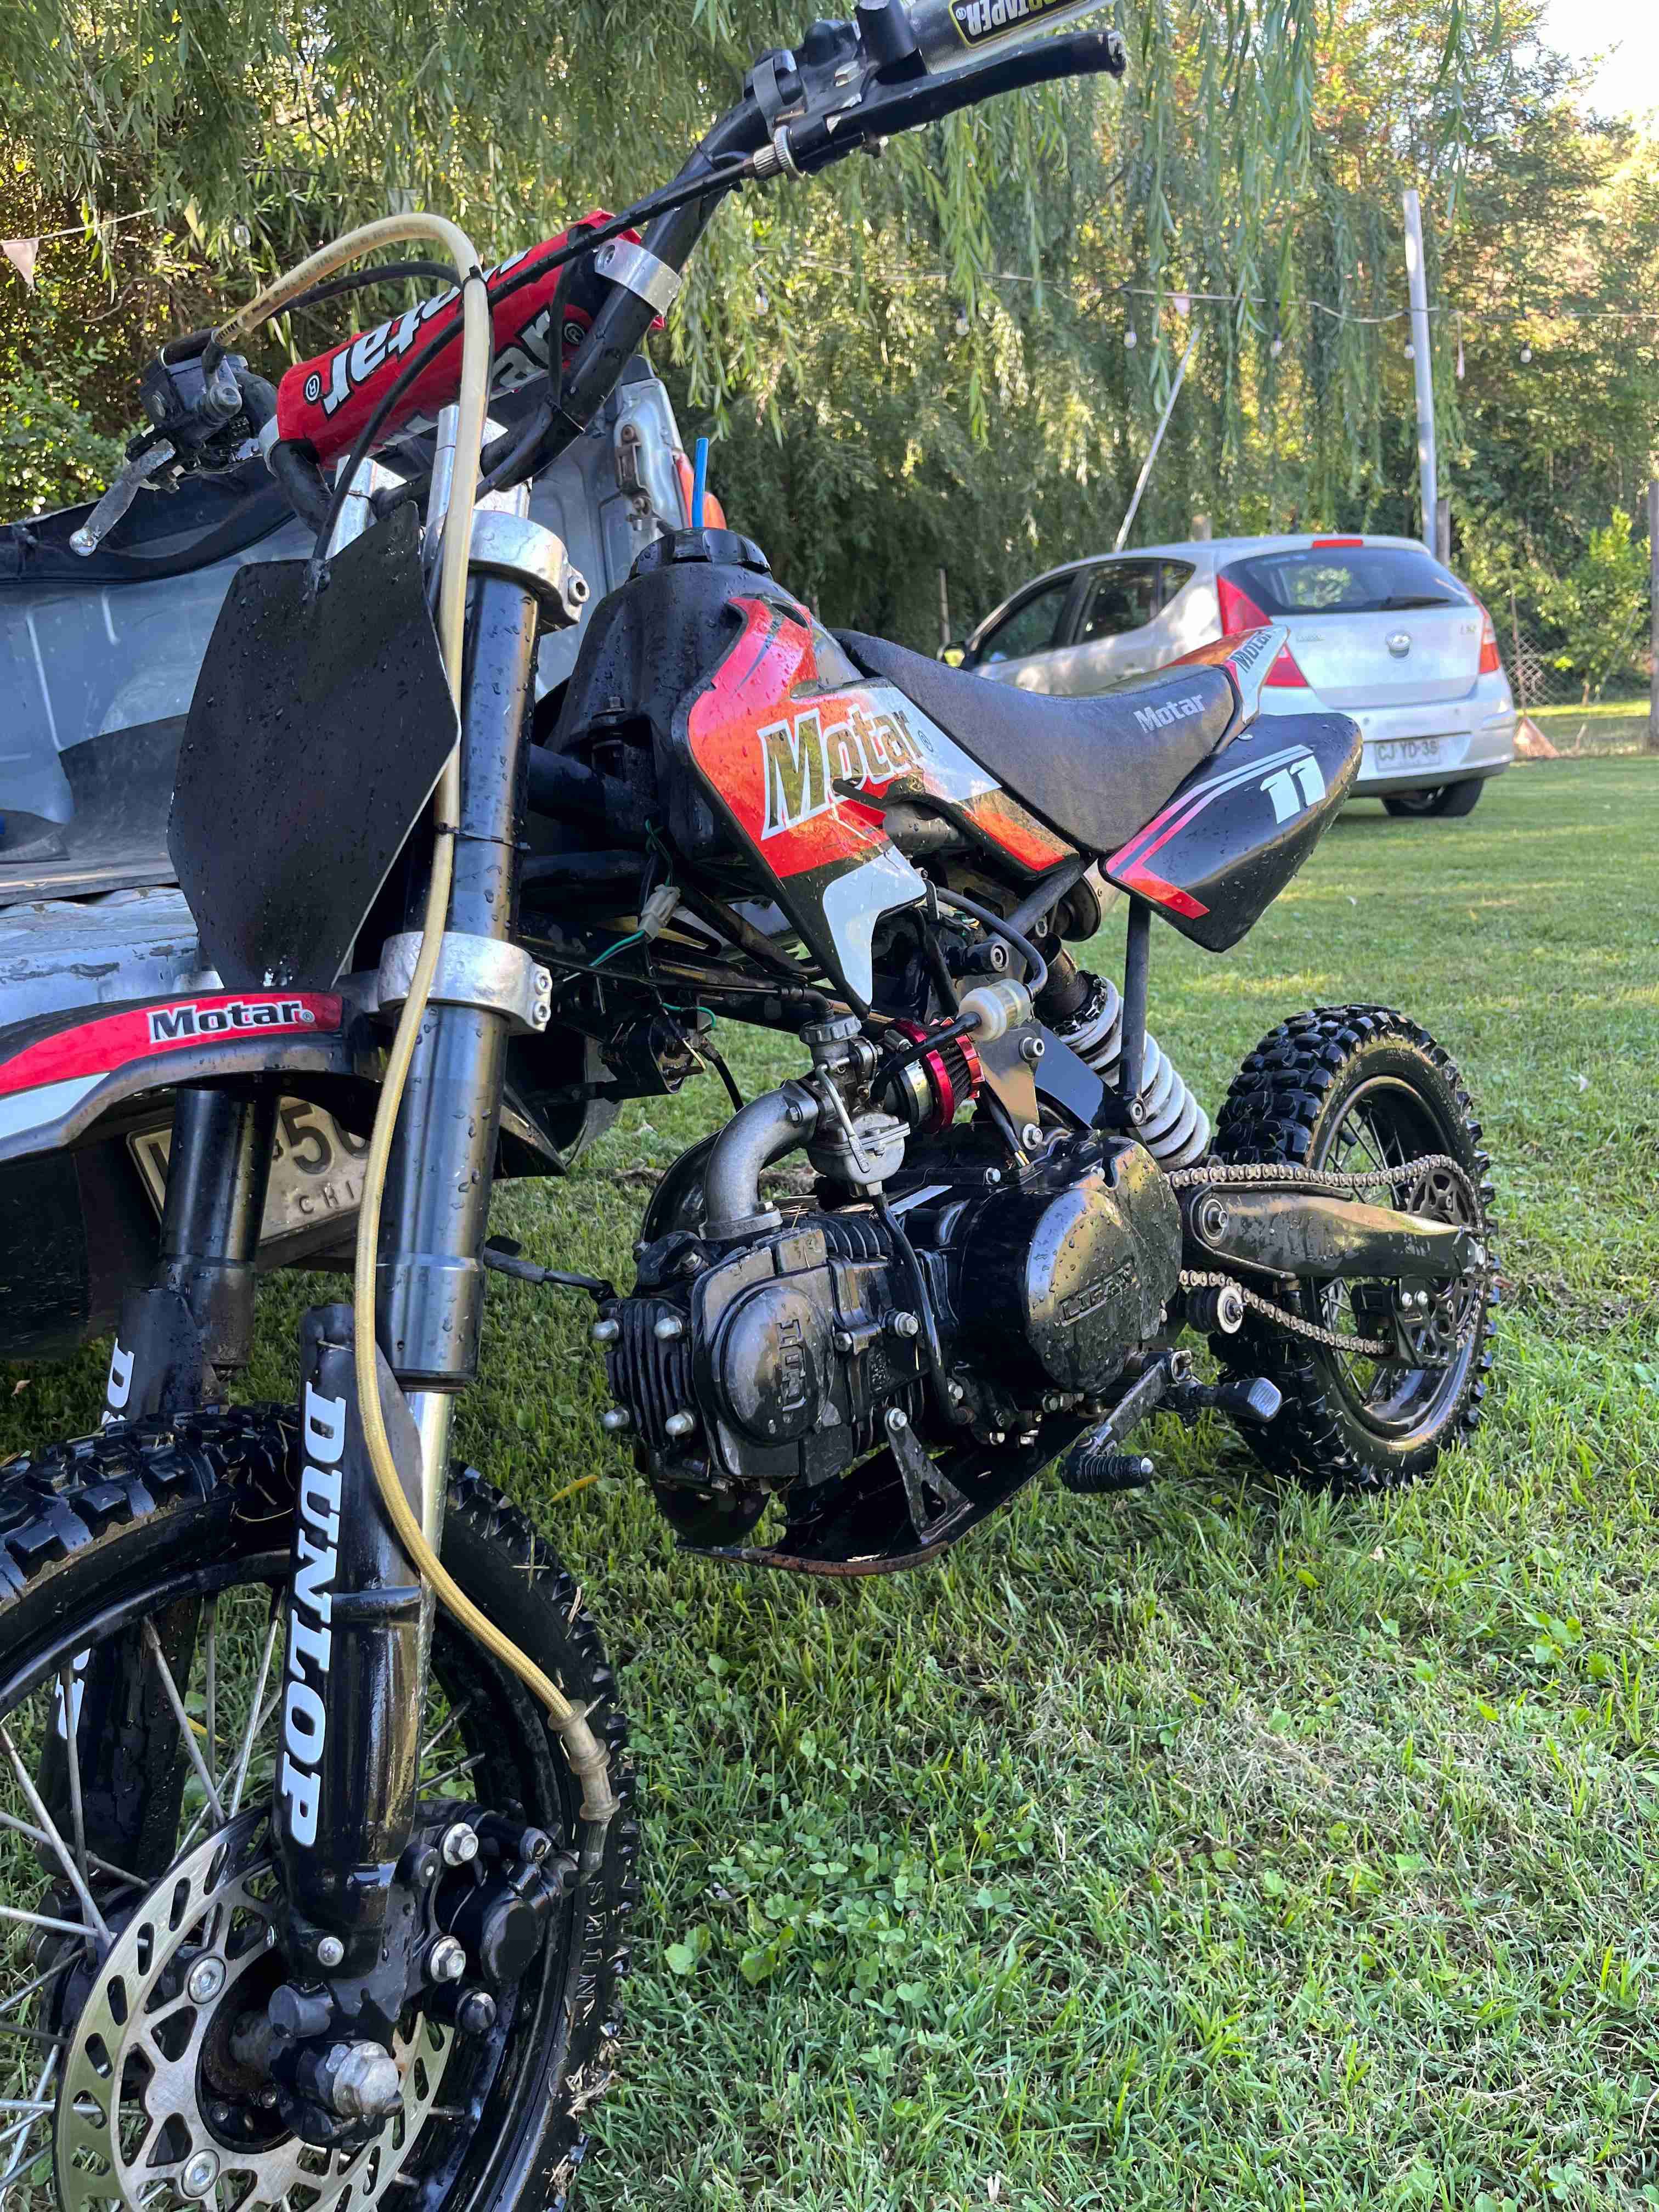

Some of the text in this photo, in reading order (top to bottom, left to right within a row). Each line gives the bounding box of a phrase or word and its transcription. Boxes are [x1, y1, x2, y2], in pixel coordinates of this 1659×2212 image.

[966, 0, 1056, 36] TAPER
[1133, 693, 1204, 733] Motar
[757, 704, 927, 841] Motar
[1260, 755, 1326, 824] 11
[150, 1000, 306, 1043] Motar
[299, 1180, 356, 1215] CHI
[280, 1381, 347, 1847] DUNLOP
